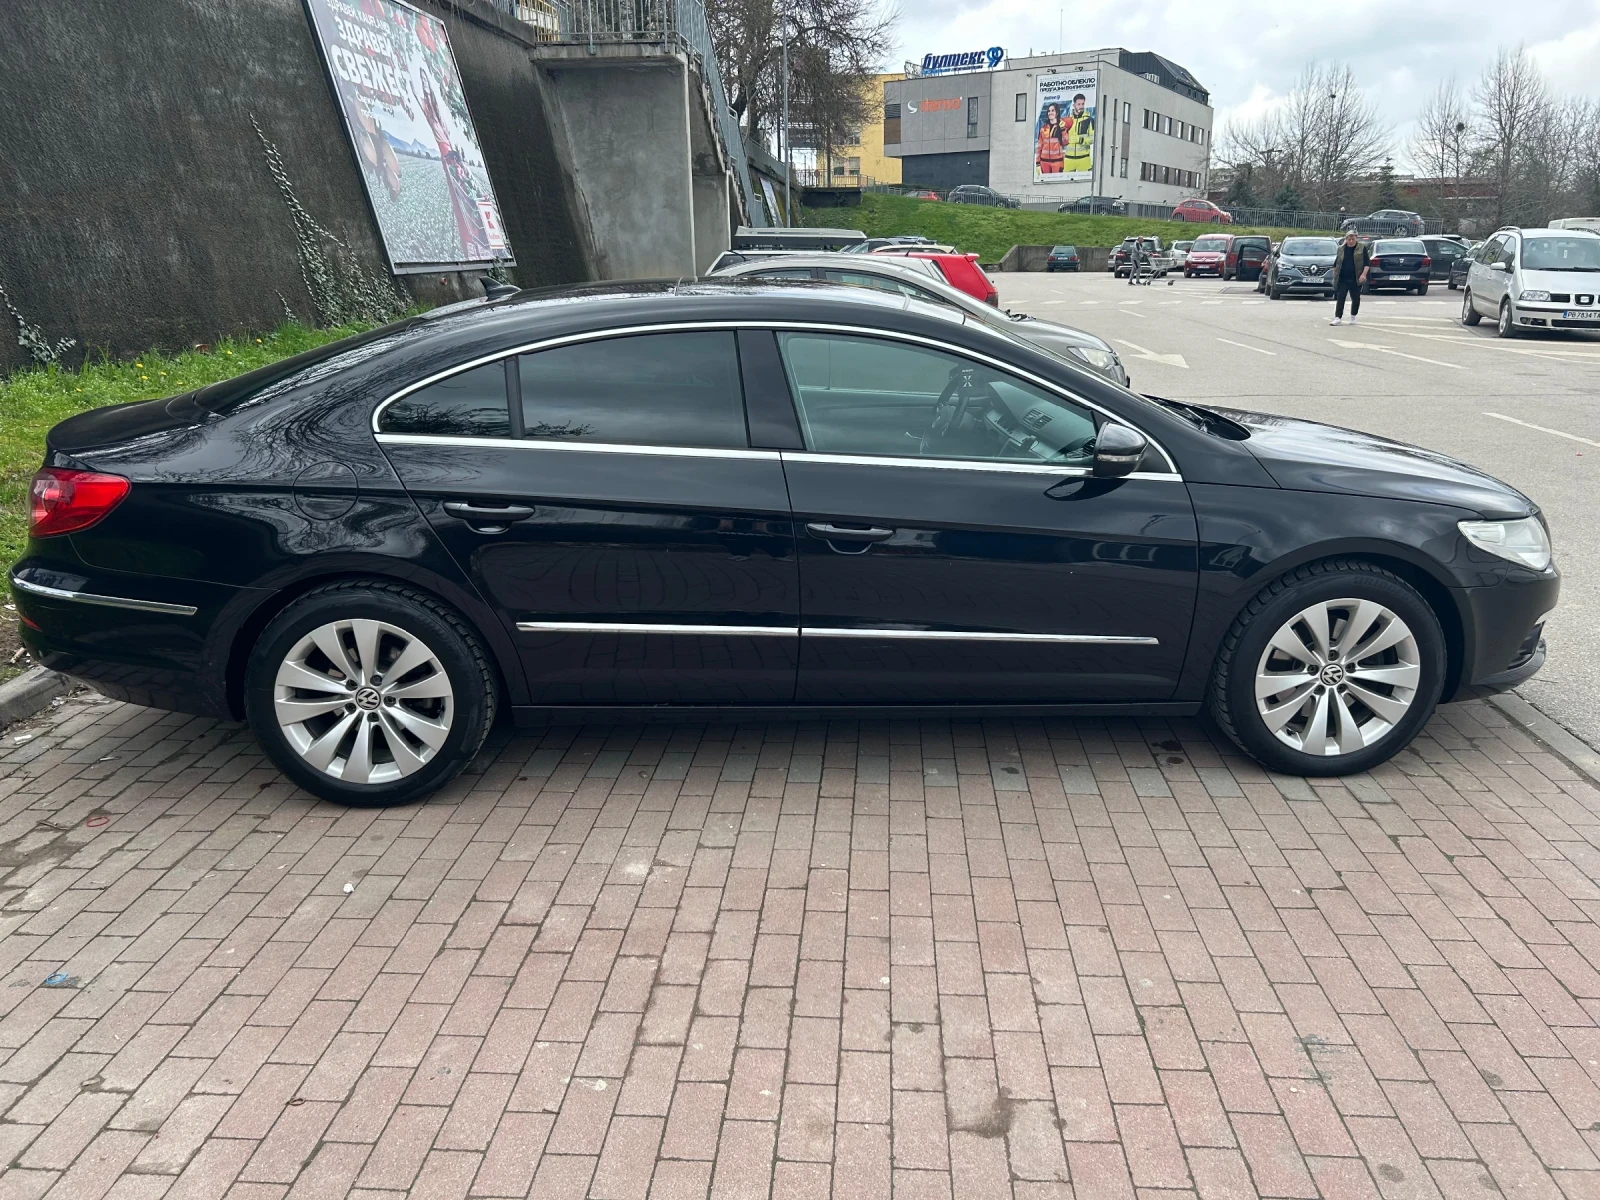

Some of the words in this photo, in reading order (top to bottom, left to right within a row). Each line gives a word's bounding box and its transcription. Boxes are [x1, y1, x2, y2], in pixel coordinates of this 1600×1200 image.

[1040, 80, 1067, 88] РАБОТНО
[1068, 77, 1096, 85] ОБЛЕКЛО
[920, 98, 961, 112] stenso
